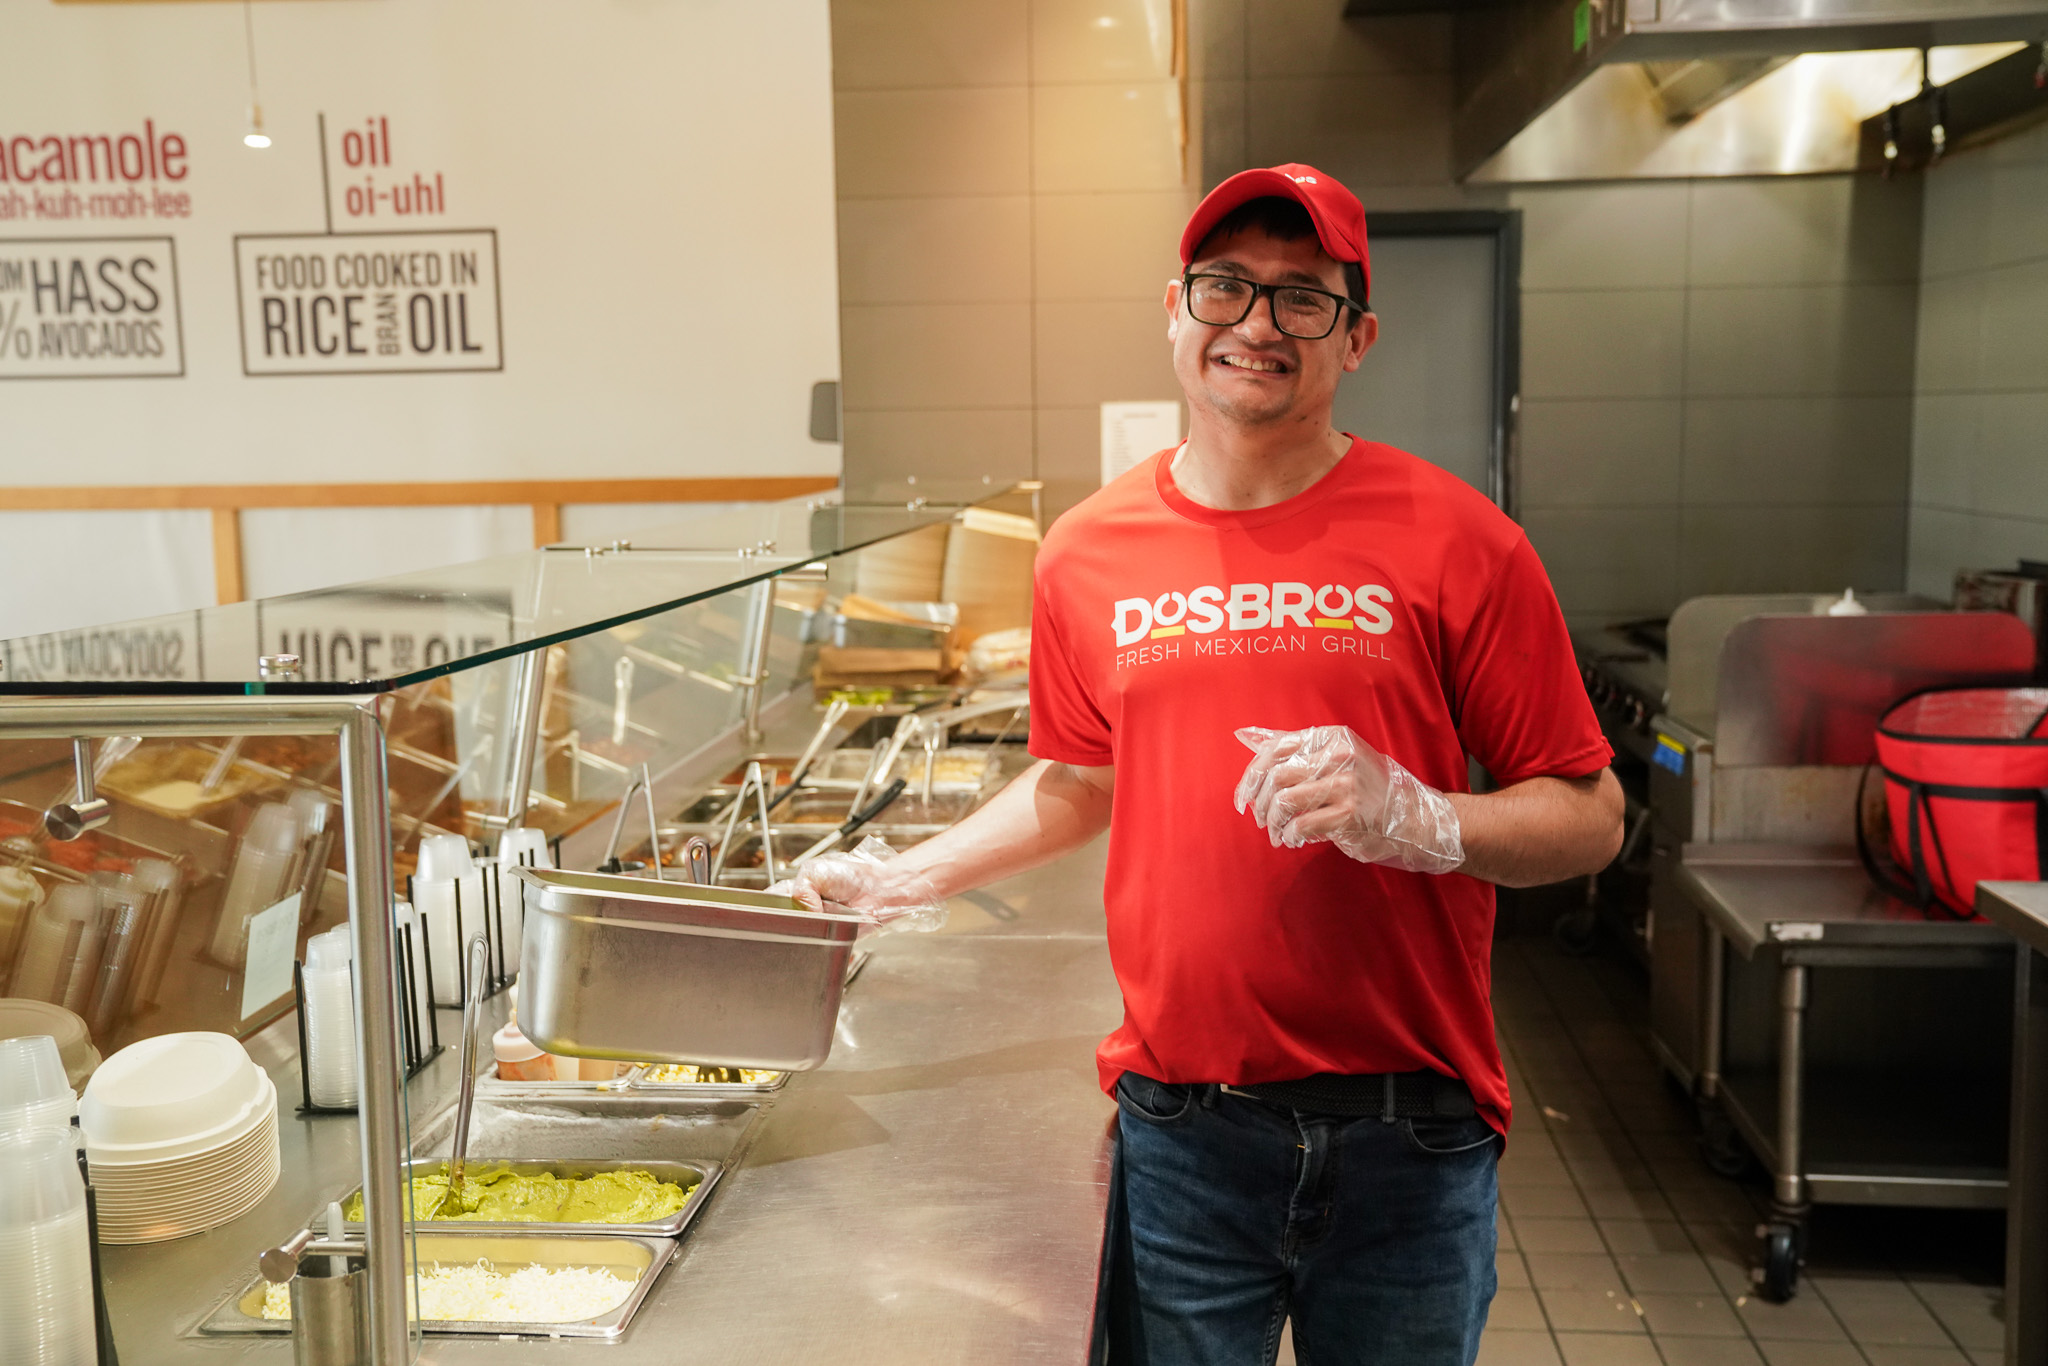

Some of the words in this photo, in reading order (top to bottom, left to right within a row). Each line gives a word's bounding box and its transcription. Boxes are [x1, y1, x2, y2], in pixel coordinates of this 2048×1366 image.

[343, 115, 391, 168] oil
[346, 171, 445, 216] oi-uhl
[31, 257, 160, 315] HASS
[256, 255, 327, 290] FOOD
[335, 252, 442, 289] COOKED
[450, 250, 478, 286] IN
[39, 319, 165, 359] AVOCADOS
[262, 295, 368, 357] RICE
[375, 292, 401, 356] BRAN
[408, 292, 483, 354] OIL
[1116, 643, 1180, 672] FRESH
[1195, 635, 1306, 657] MEXICAN
[1322, 635, 1391, 661] GRILL
